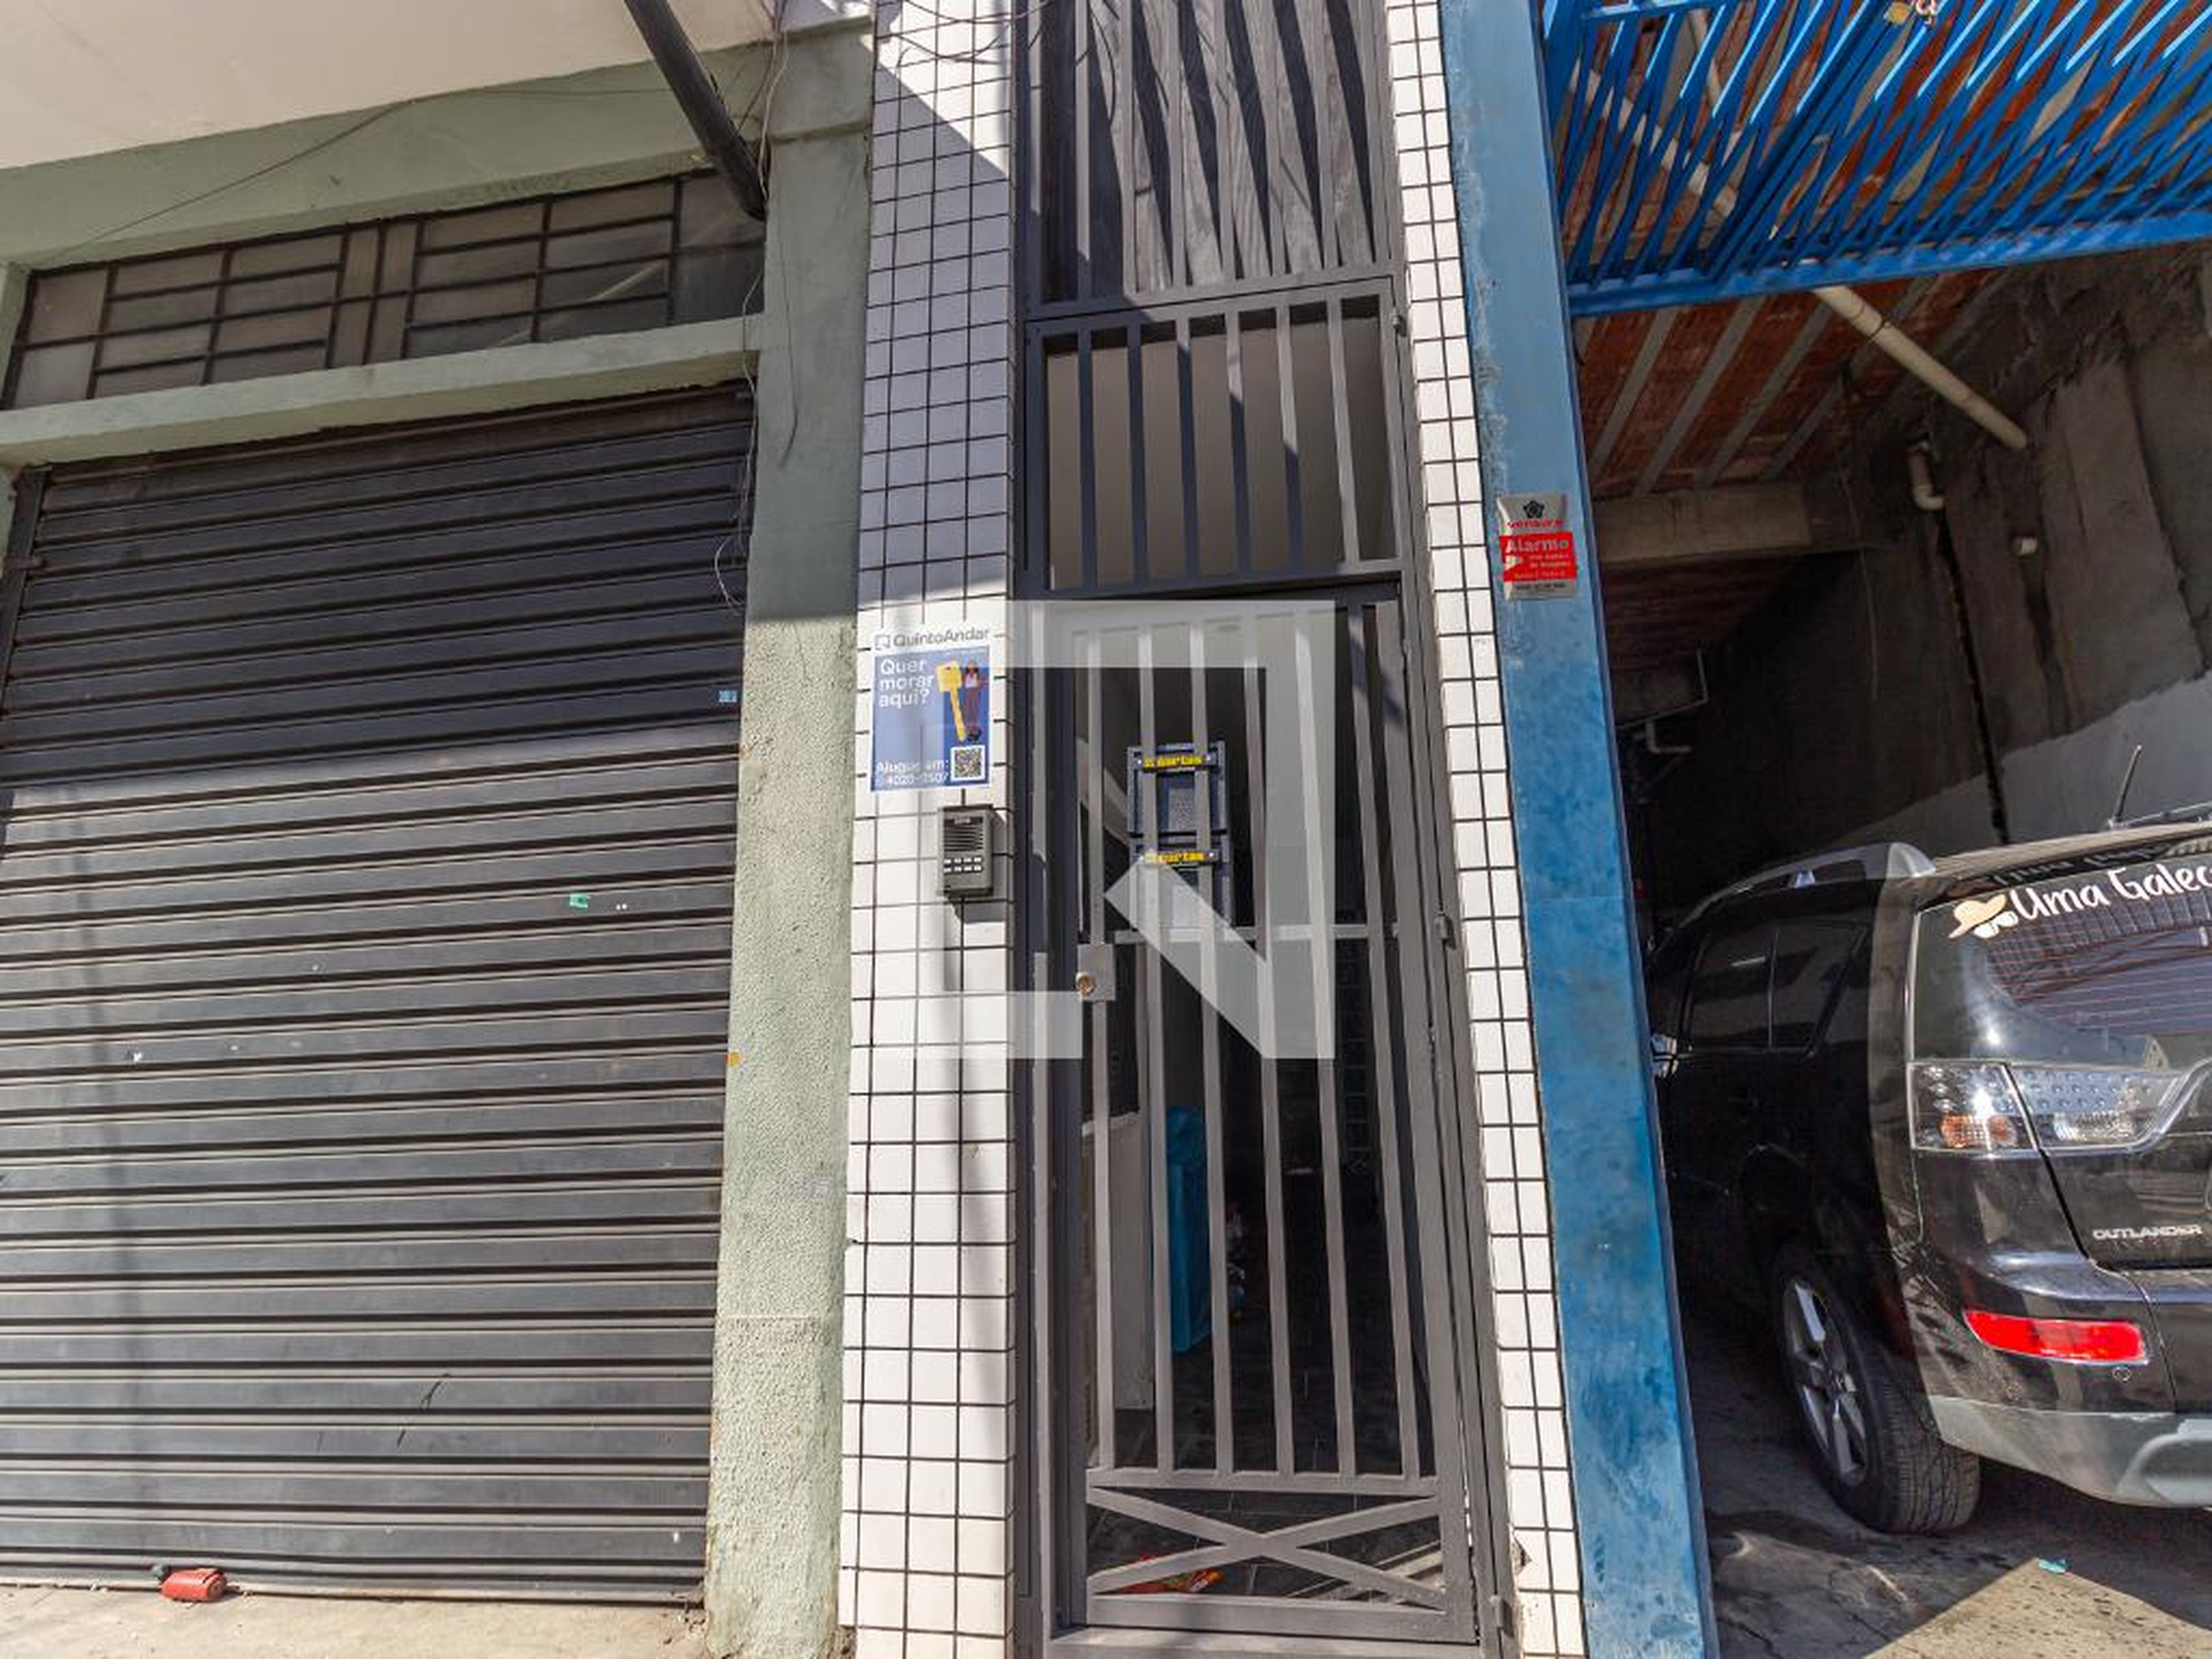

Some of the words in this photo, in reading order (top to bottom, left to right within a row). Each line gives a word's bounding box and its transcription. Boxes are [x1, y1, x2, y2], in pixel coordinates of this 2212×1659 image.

[893, 627, 989, 646] QuintoAndar
[880, 659, 927, 675] Quer
[879, 675, 934, 691] morar
[878, 688, 930, 709] aqui?
[2010, 883, 2112, 921] Uma
[2092, 1224, 2204, 1240] OUTLANDER
